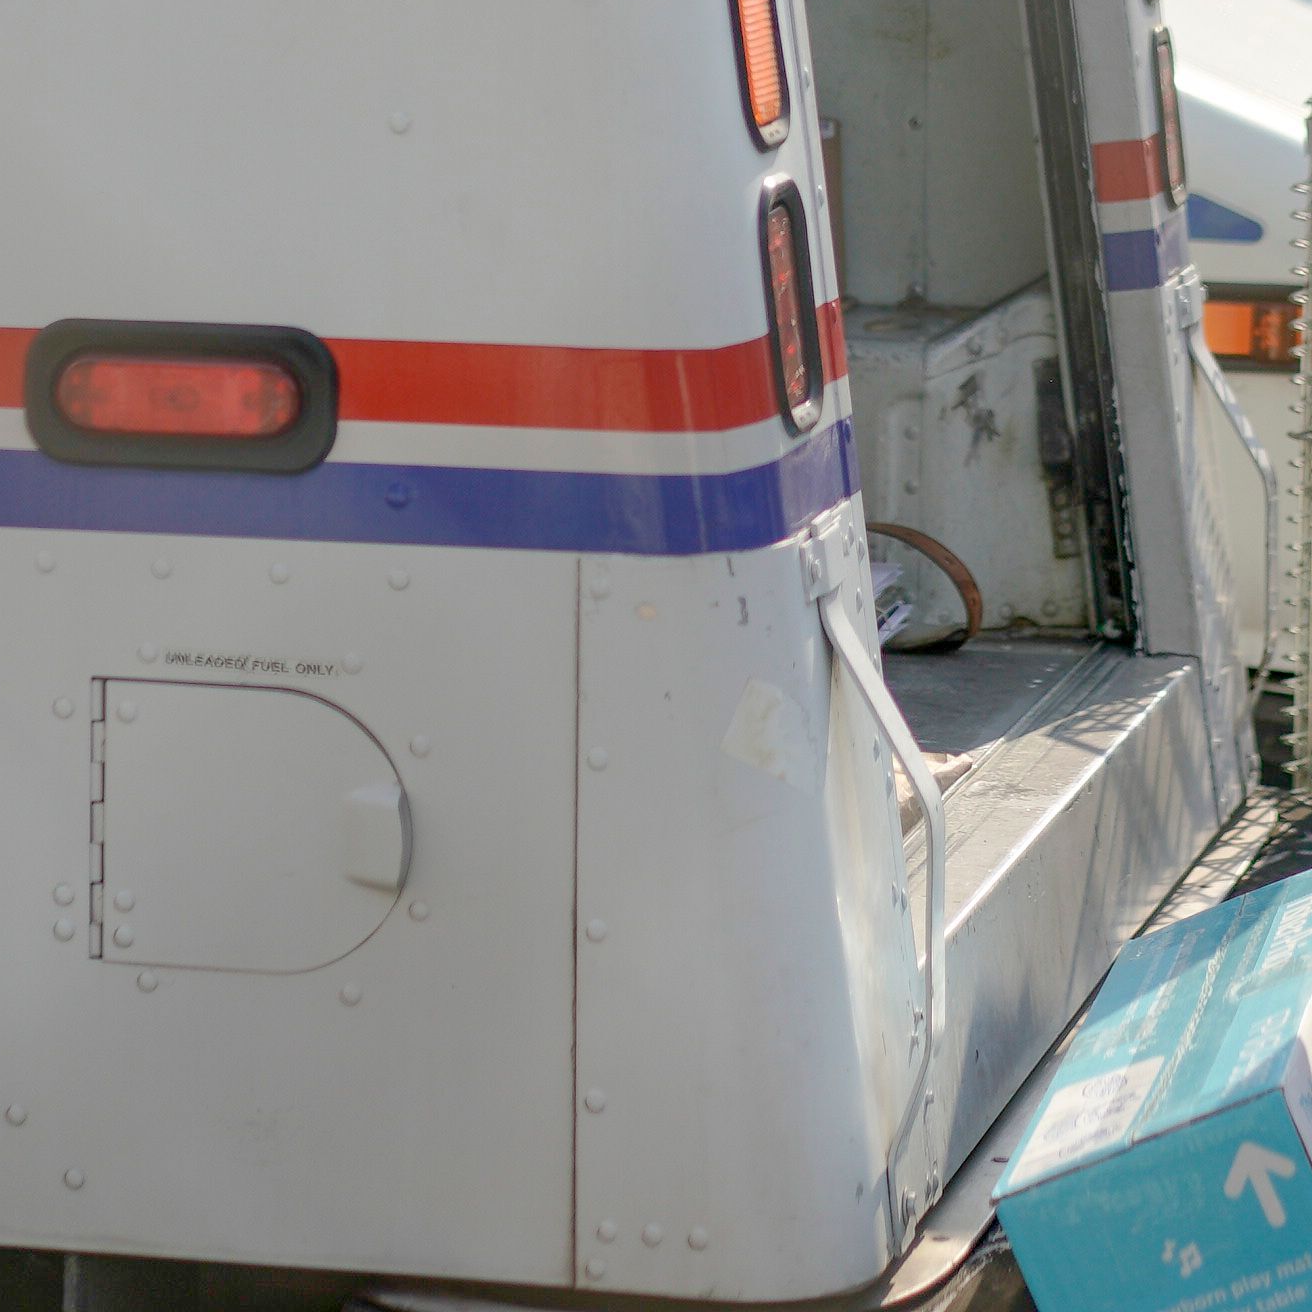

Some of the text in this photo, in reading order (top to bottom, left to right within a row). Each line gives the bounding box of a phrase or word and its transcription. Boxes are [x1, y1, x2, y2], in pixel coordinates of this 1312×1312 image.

[165, 651, 334, 675] UNLEADED FUEL ONLY
